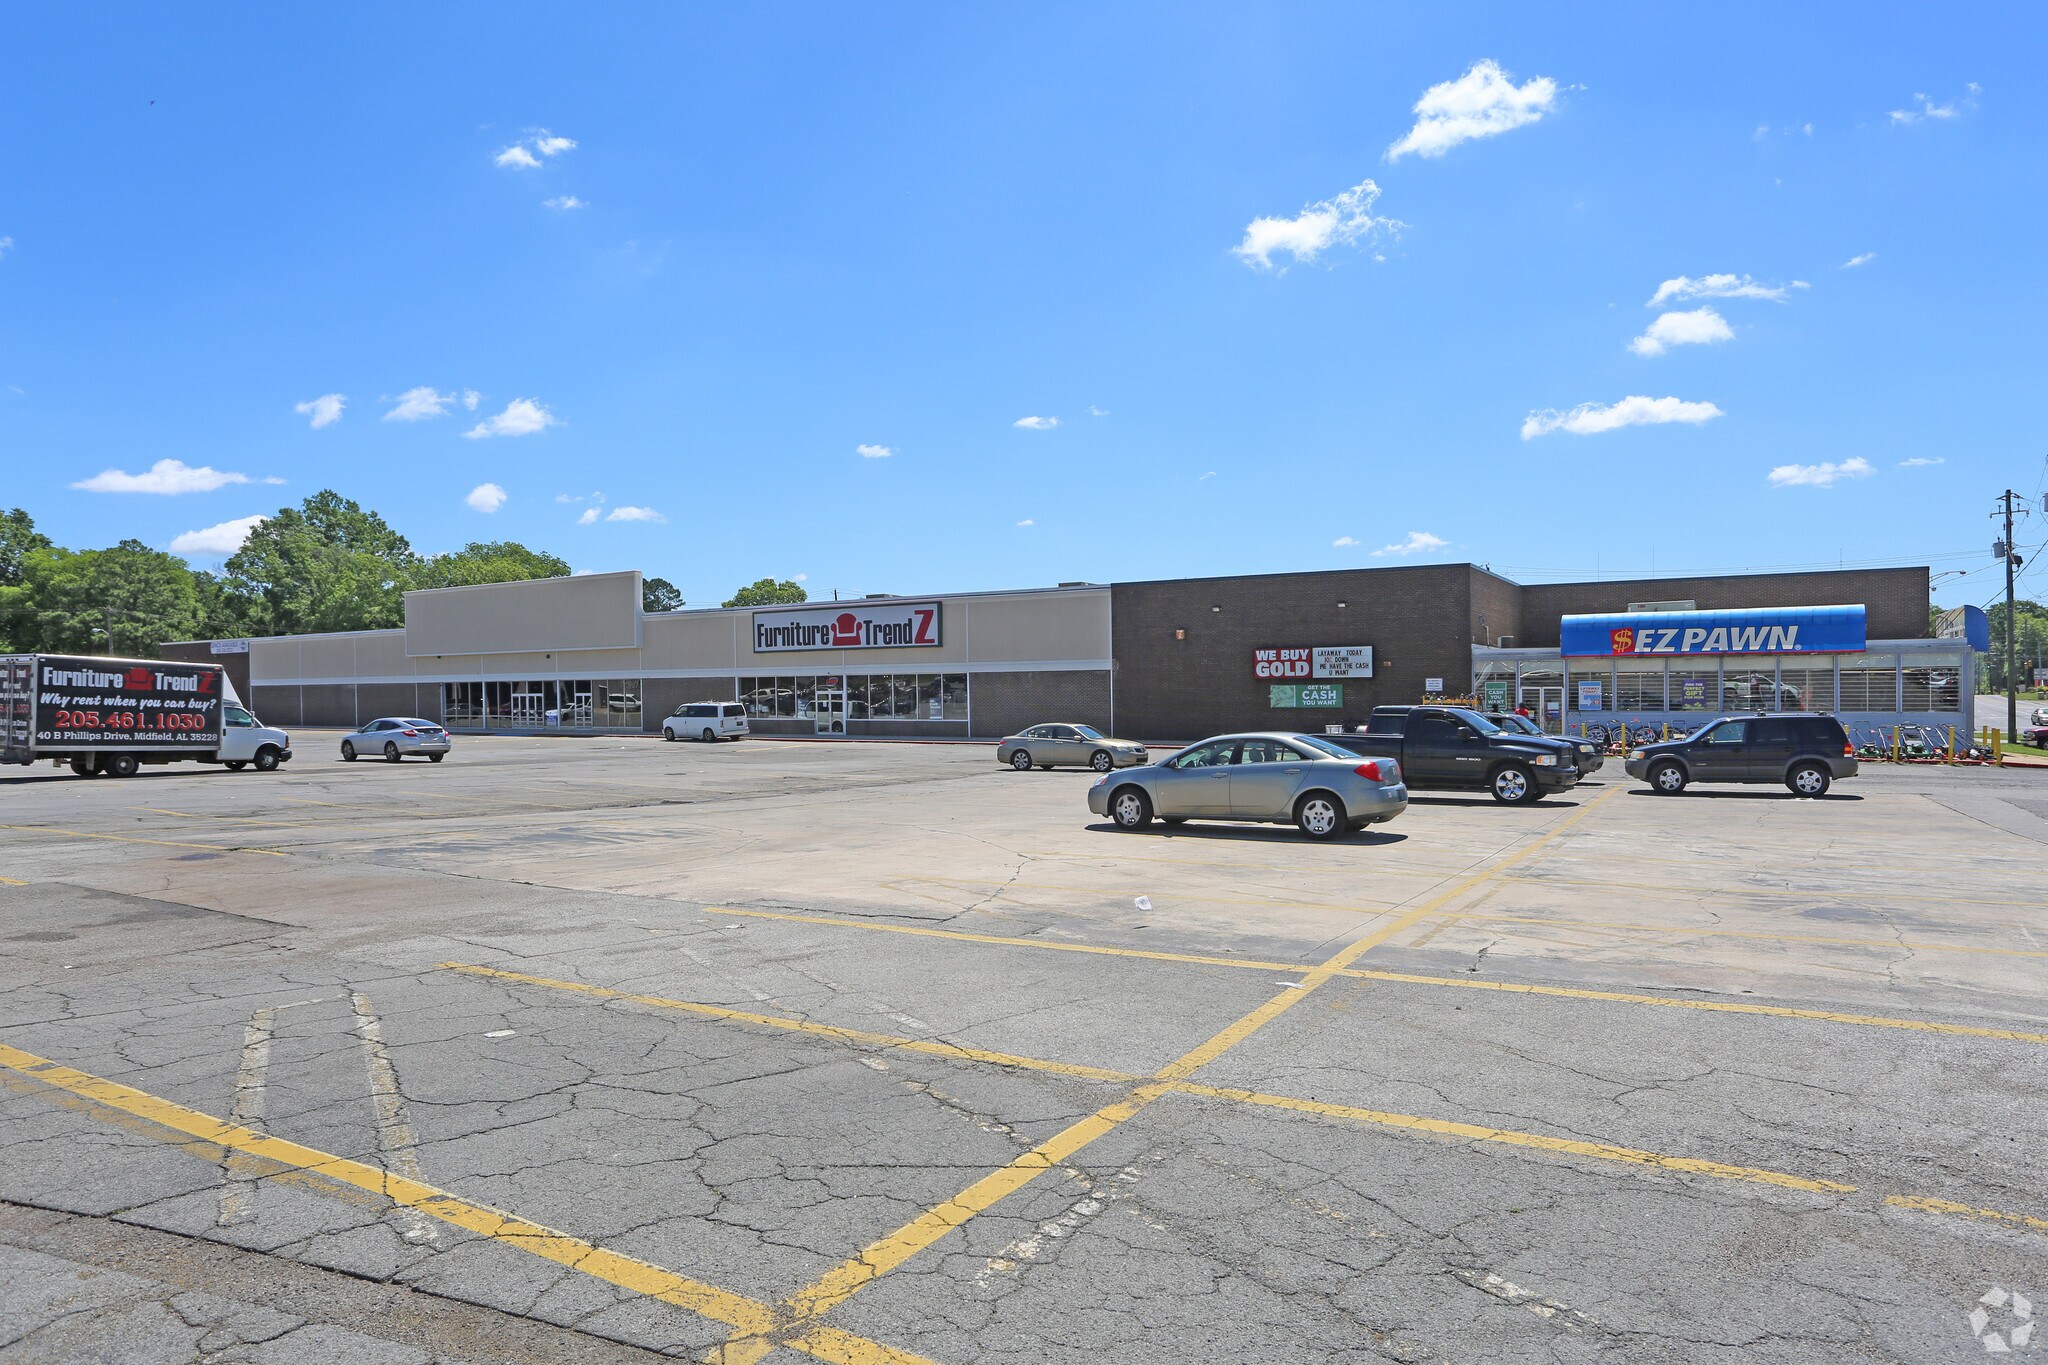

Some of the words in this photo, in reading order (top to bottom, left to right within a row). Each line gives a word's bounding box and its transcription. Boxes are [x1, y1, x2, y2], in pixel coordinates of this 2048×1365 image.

[757, 621, 829, 648] Furniture
[1256, 650, 1276, 660] WE
[1281, 649, 1309, 660] BUY
[43, 666, 123, 688] Furniture
[1256, 661, 1309, 677] GOLD
[40, 692, 71, 708] Why
[72, 695, 101, 705] rent
[103, 695, 138, 707] when
[139, 698, 162, 710] you
[163, 699, 186, 708] can
[188, 698, 217, 711] buy?
[1302, 690, 1337, 700] CASH
[55, 710, 205, 730] 205.461.1030
[37, 731, 51, 740] 40
[53, 732, 61, 740] B
[64, 731, 101, 741] Phillips
[176, 733, 188, 741] AL
[190, 733, 218, 741] 35228
